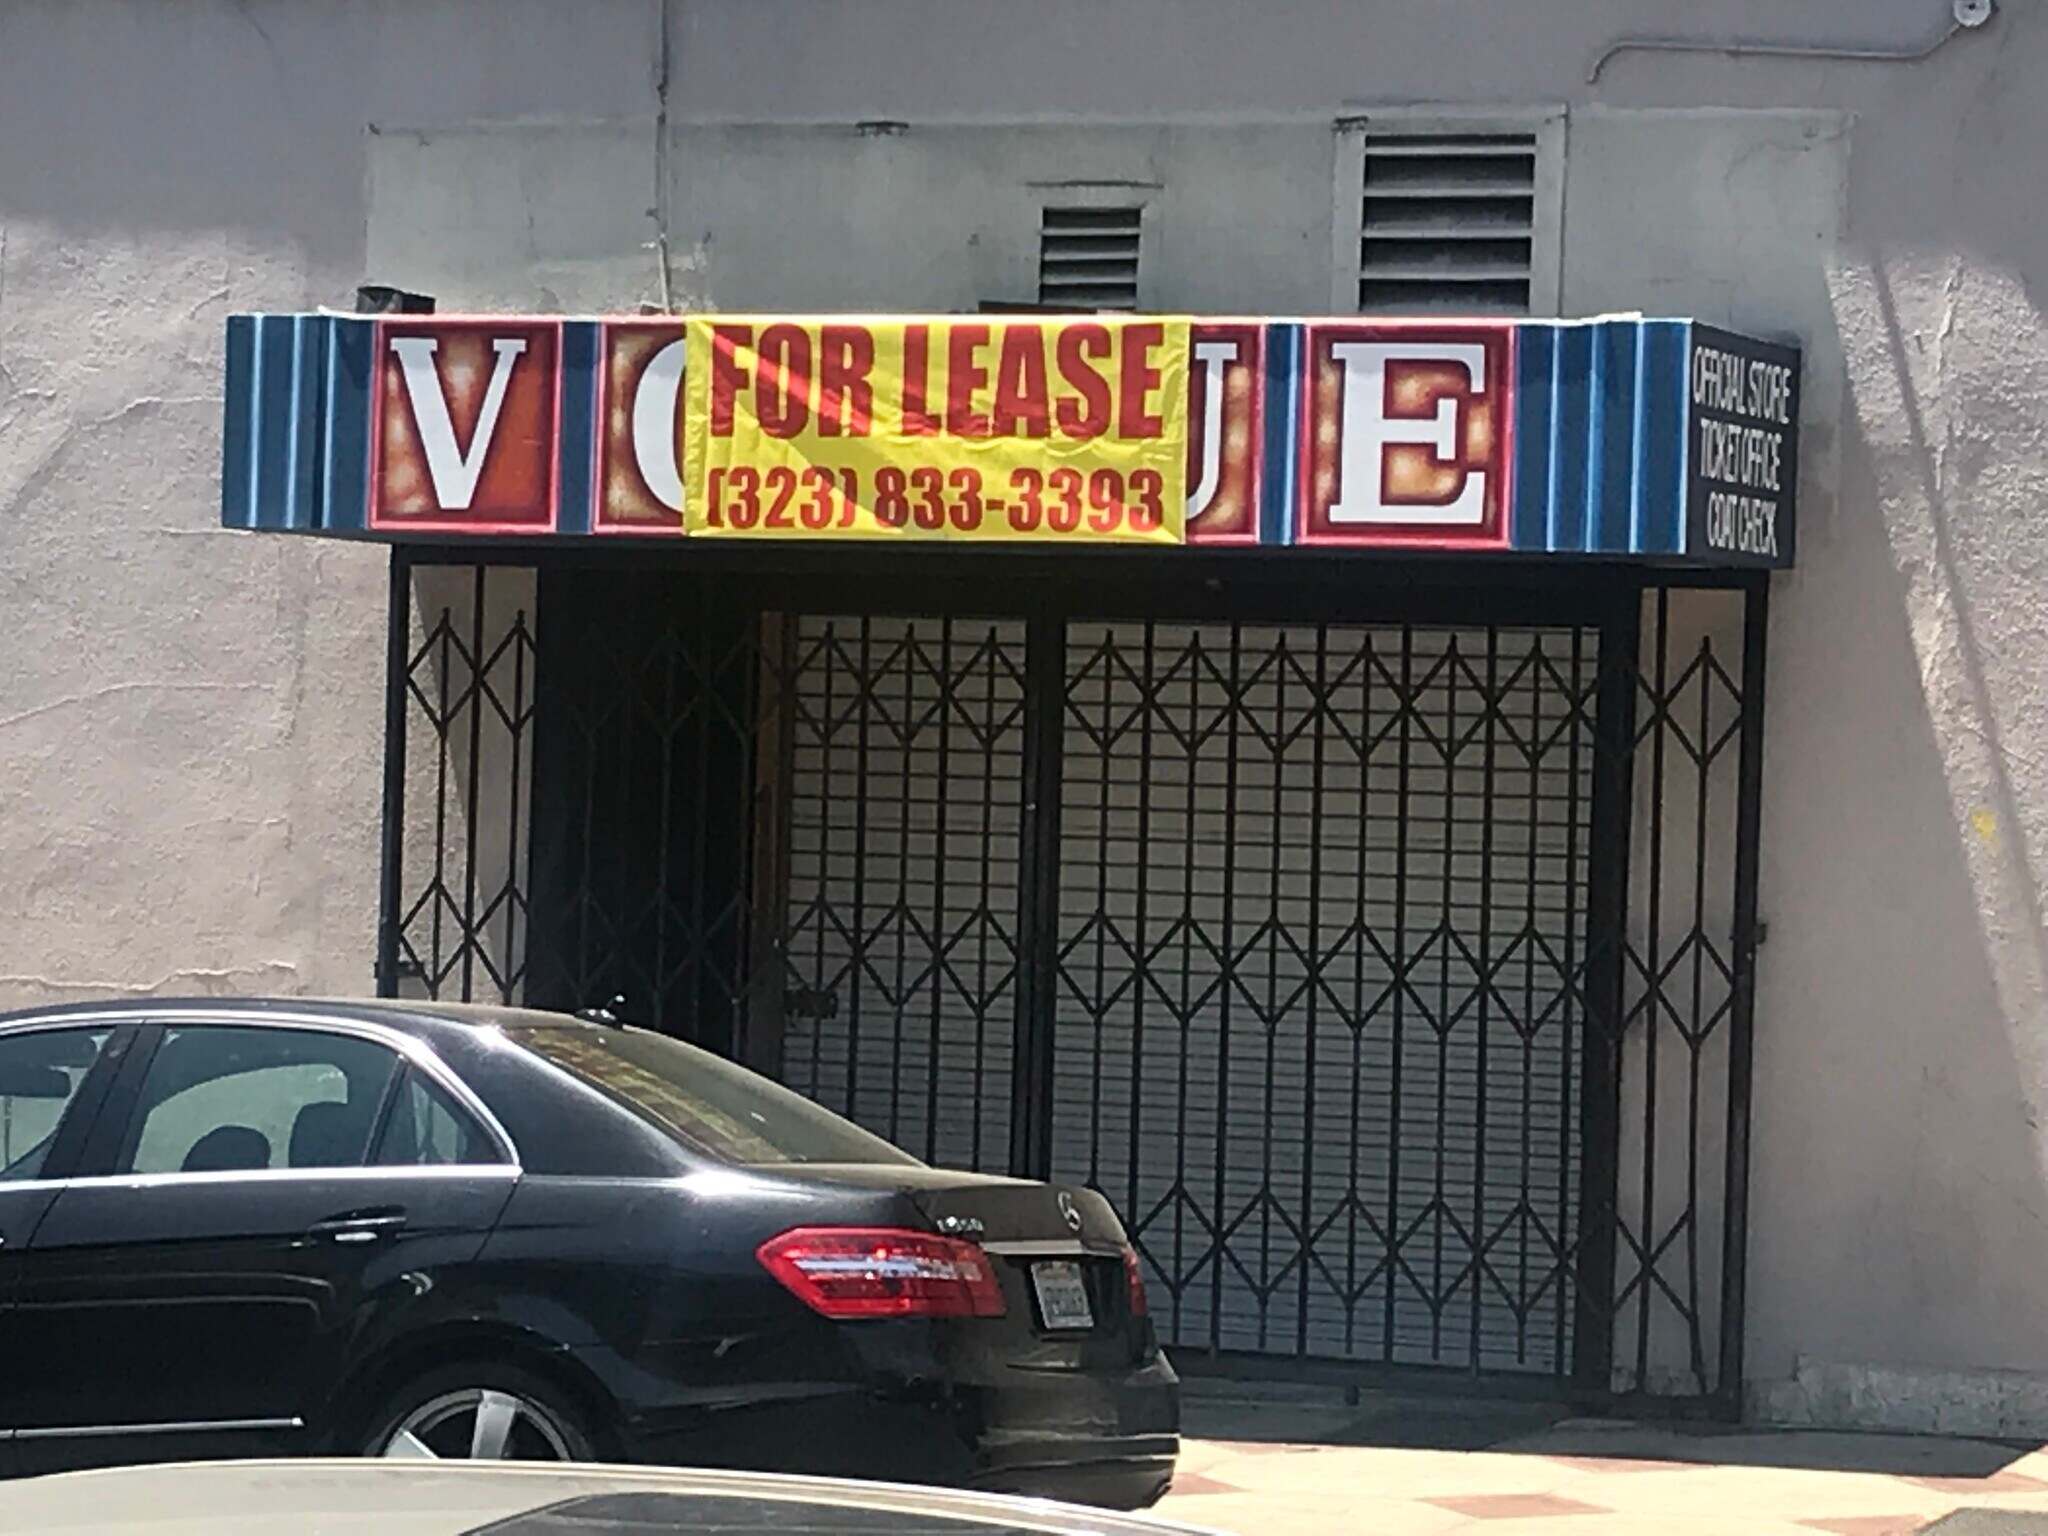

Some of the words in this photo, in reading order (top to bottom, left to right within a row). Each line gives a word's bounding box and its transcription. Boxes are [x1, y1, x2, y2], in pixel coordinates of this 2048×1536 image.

[710, 323, 875, 439] FOR
[901, 323, 1164, 440] LEASE
[1693, 345, 1746, 414] OFFICIAL
[1700, 417, 1742, 483] TICKET
[1741, 427, 1782, 492] OFFICE
[707, 466, 858, 529] (323)
[875, 466, 1164, 532] 833-3393
[1738, 496, 1779, 557] CHECK
